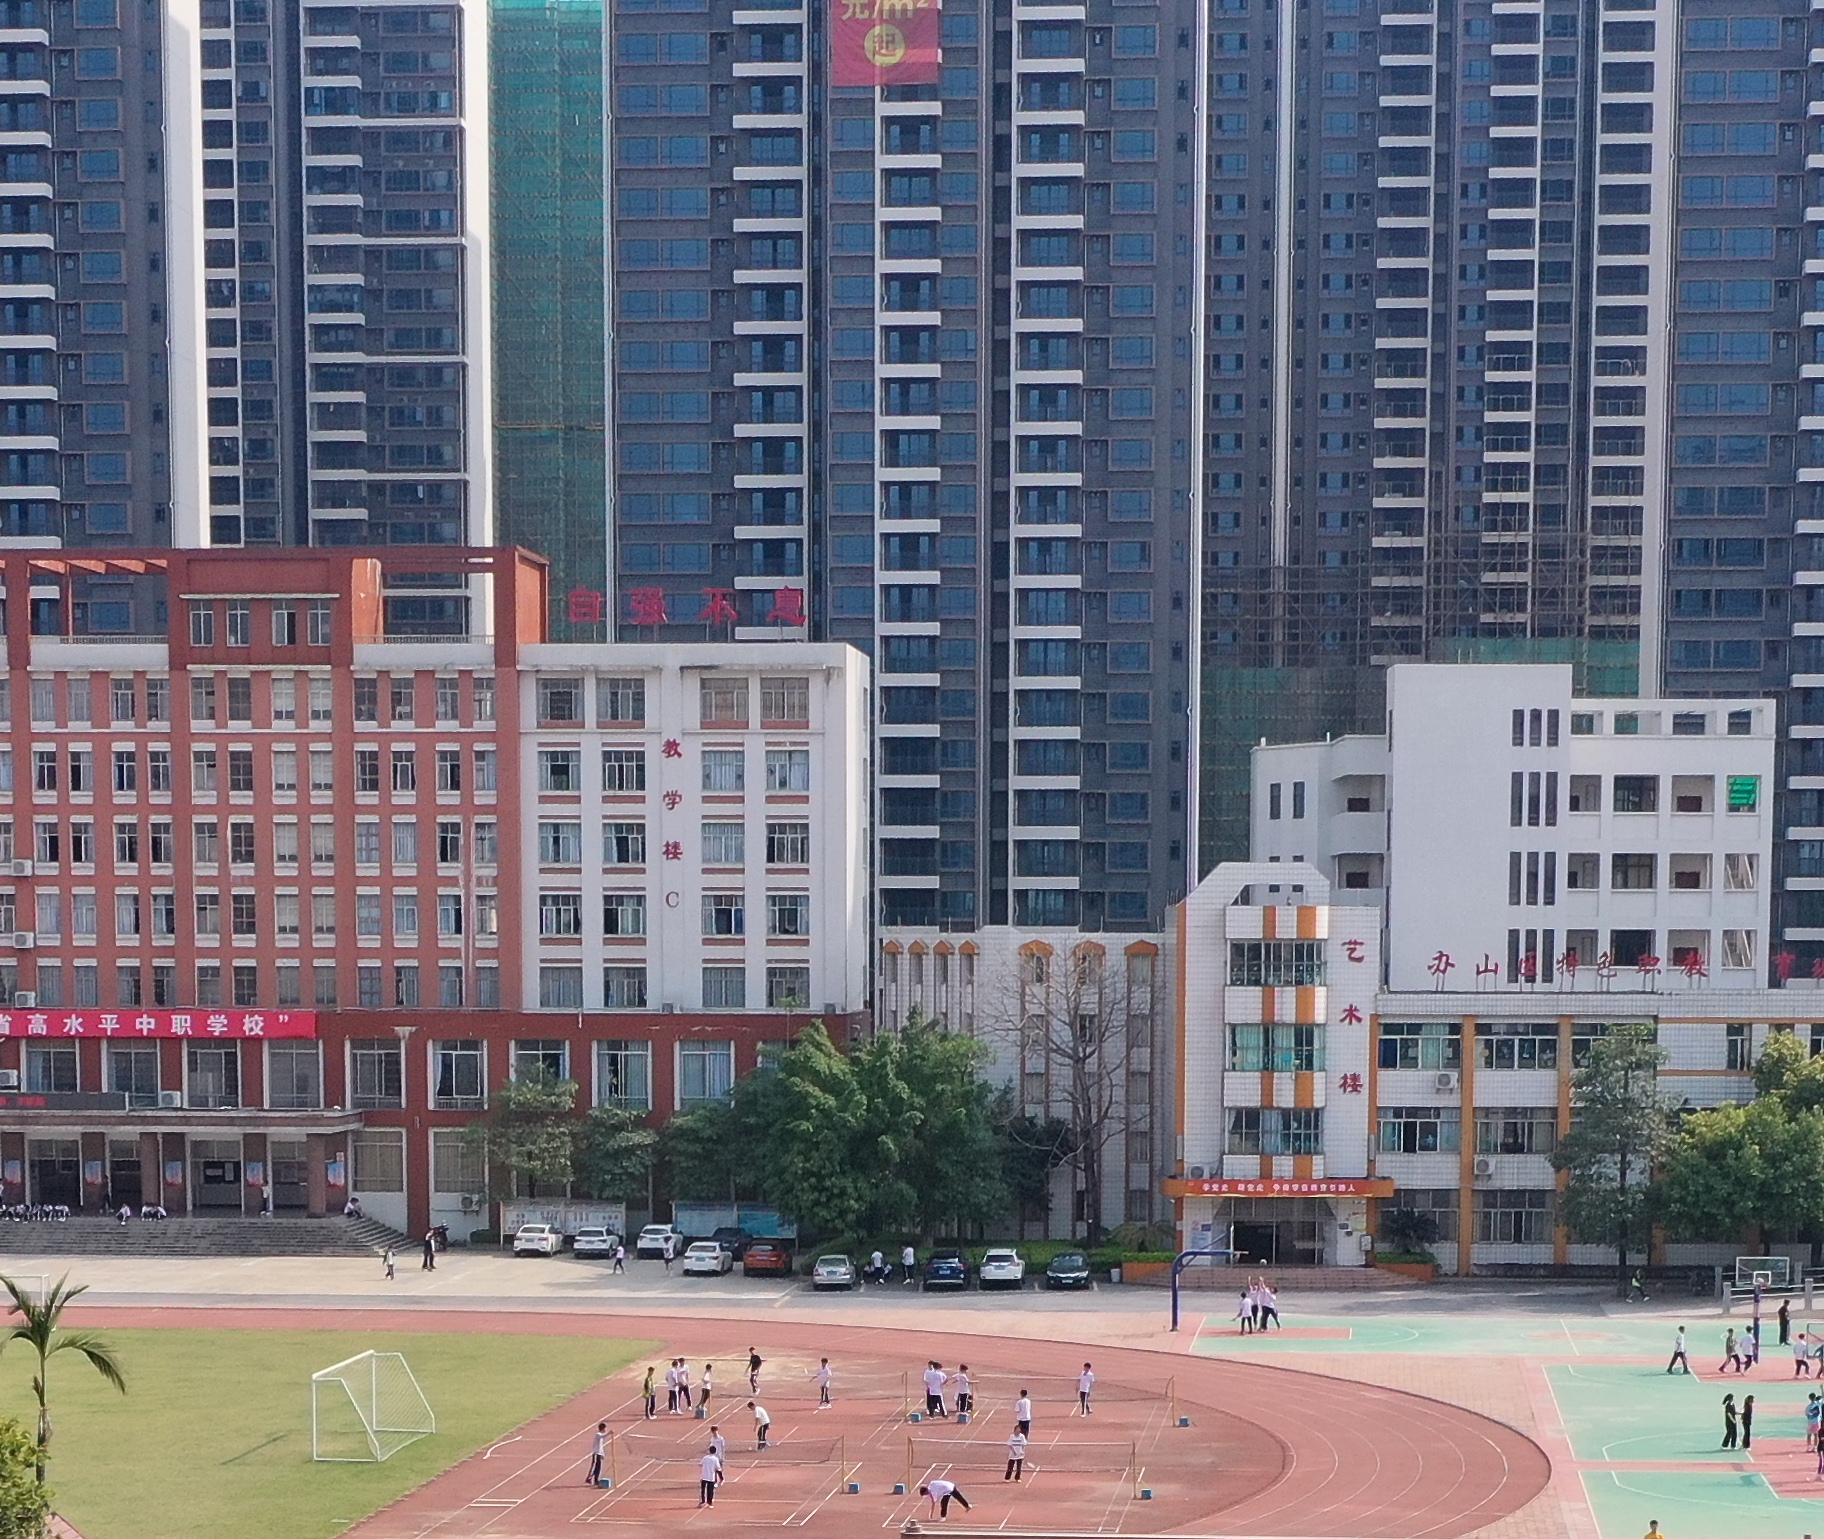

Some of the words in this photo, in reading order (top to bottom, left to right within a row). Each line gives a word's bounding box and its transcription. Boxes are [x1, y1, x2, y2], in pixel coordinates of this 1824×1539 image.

[567, 585, 806, 627] 自强不息
[1339, 939, 1365, 1094] 艺术楼
